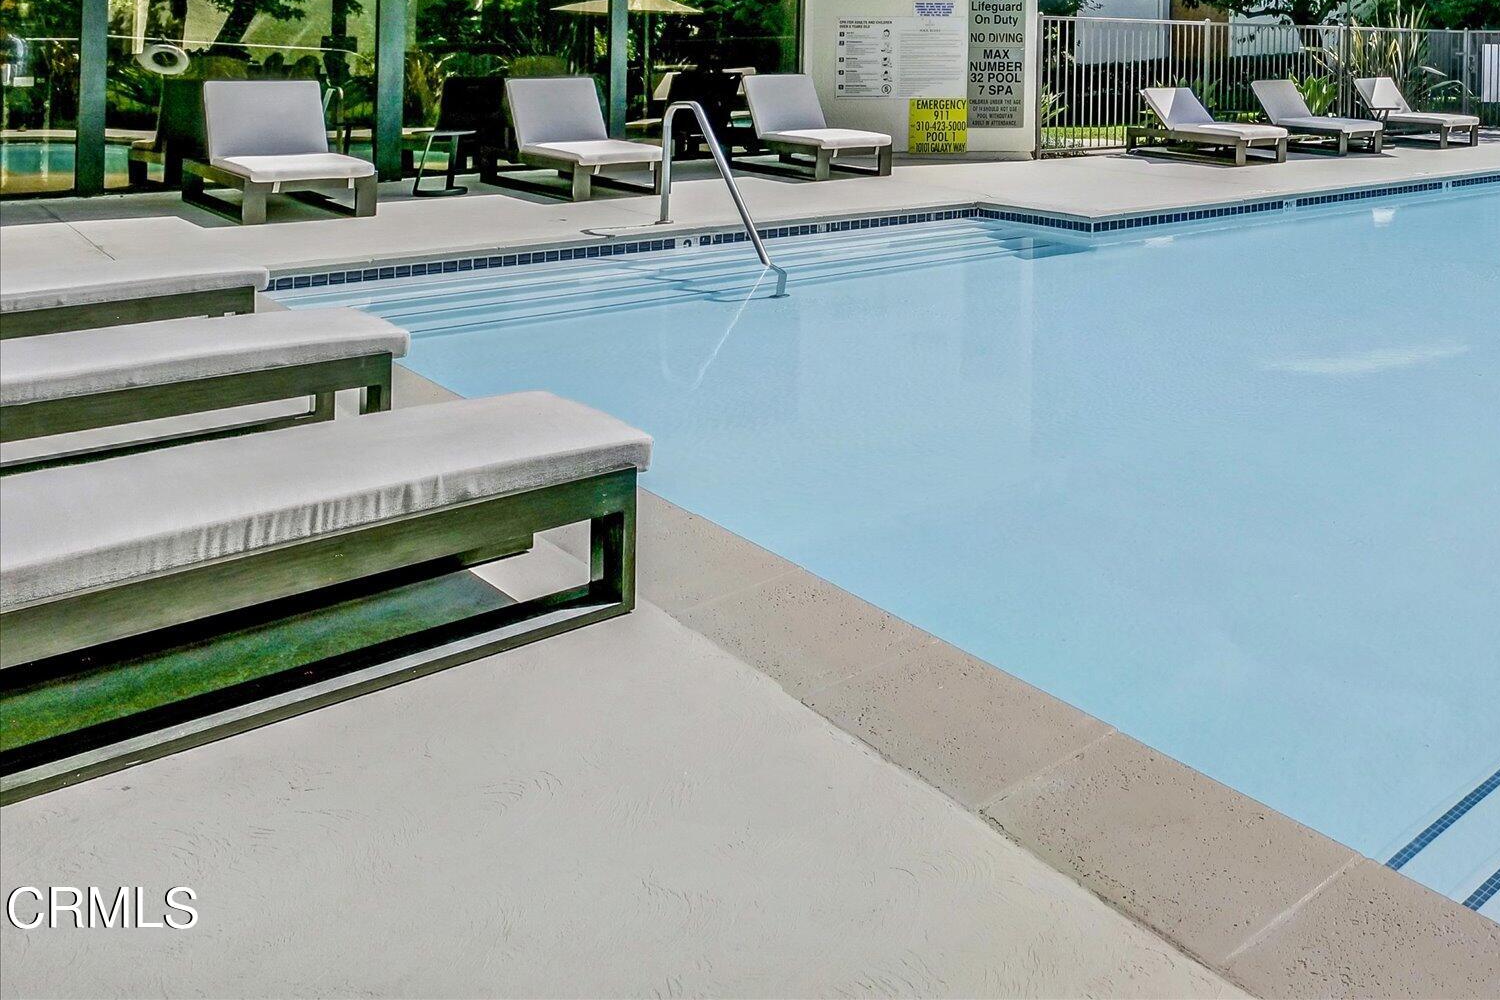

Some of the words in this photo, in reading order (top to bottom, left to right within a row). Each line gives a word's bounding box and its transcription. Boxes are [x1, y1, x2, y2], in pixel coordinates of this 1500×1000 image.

[971, 1, 1022, 13] Lifeguard
[974, 14, 990, 24] On
[994, 14, 1018, 27] Duty
[970, 33, 985, 43] NO
[989, 33, 1023, 43] DIVING
[983, 49, 1009, 59] MAX
[970, 61, 1022, 71] NUMBER
[970, 73, 983, 83] 32
[988, 73, 1021, 83] POOL
[978, 85, 985, 95] 7
[988, 85, 1013, 95] SPA
[916, 99, 967, 110] EMERGENCY
[934, 110, 949, 120] 911
[916, 121, 966, 131] 310-423-5000
[926, 132, 949, 142] POOL
[930, 143, 951, 152] GALAXY
[952, 143, 966, 152] WAY
